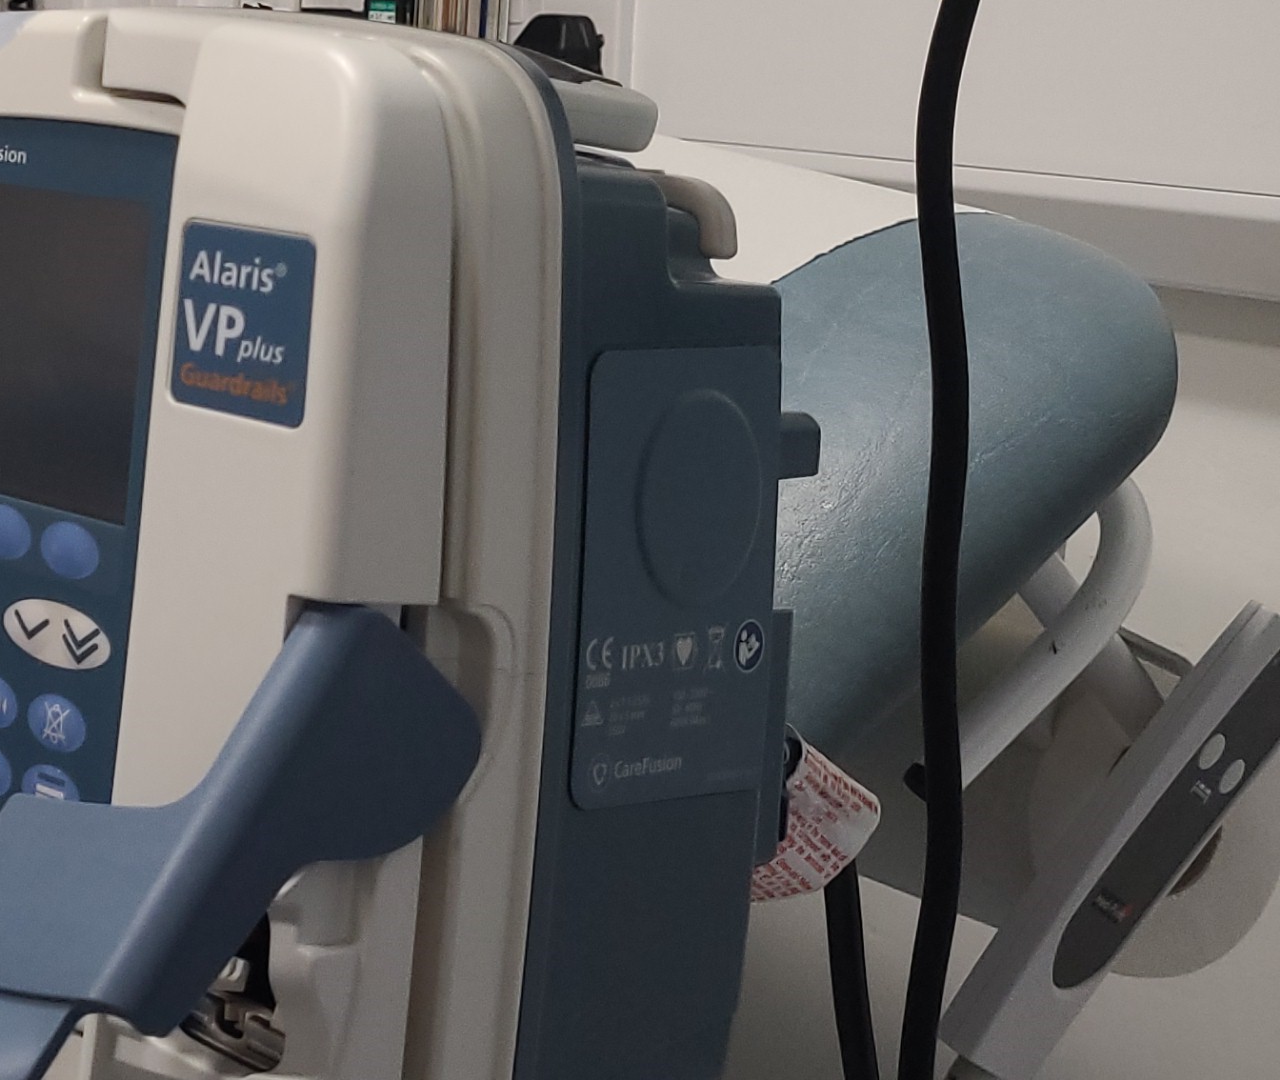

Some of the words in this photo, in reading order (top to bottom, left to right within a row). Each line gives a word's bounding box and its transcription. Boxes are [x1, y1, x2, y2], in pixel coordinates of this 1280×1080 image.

[183, 297, 245, 357] VP
[237, 336, 285, 365] plus
[614, 757, 682, 780] CareFusion
